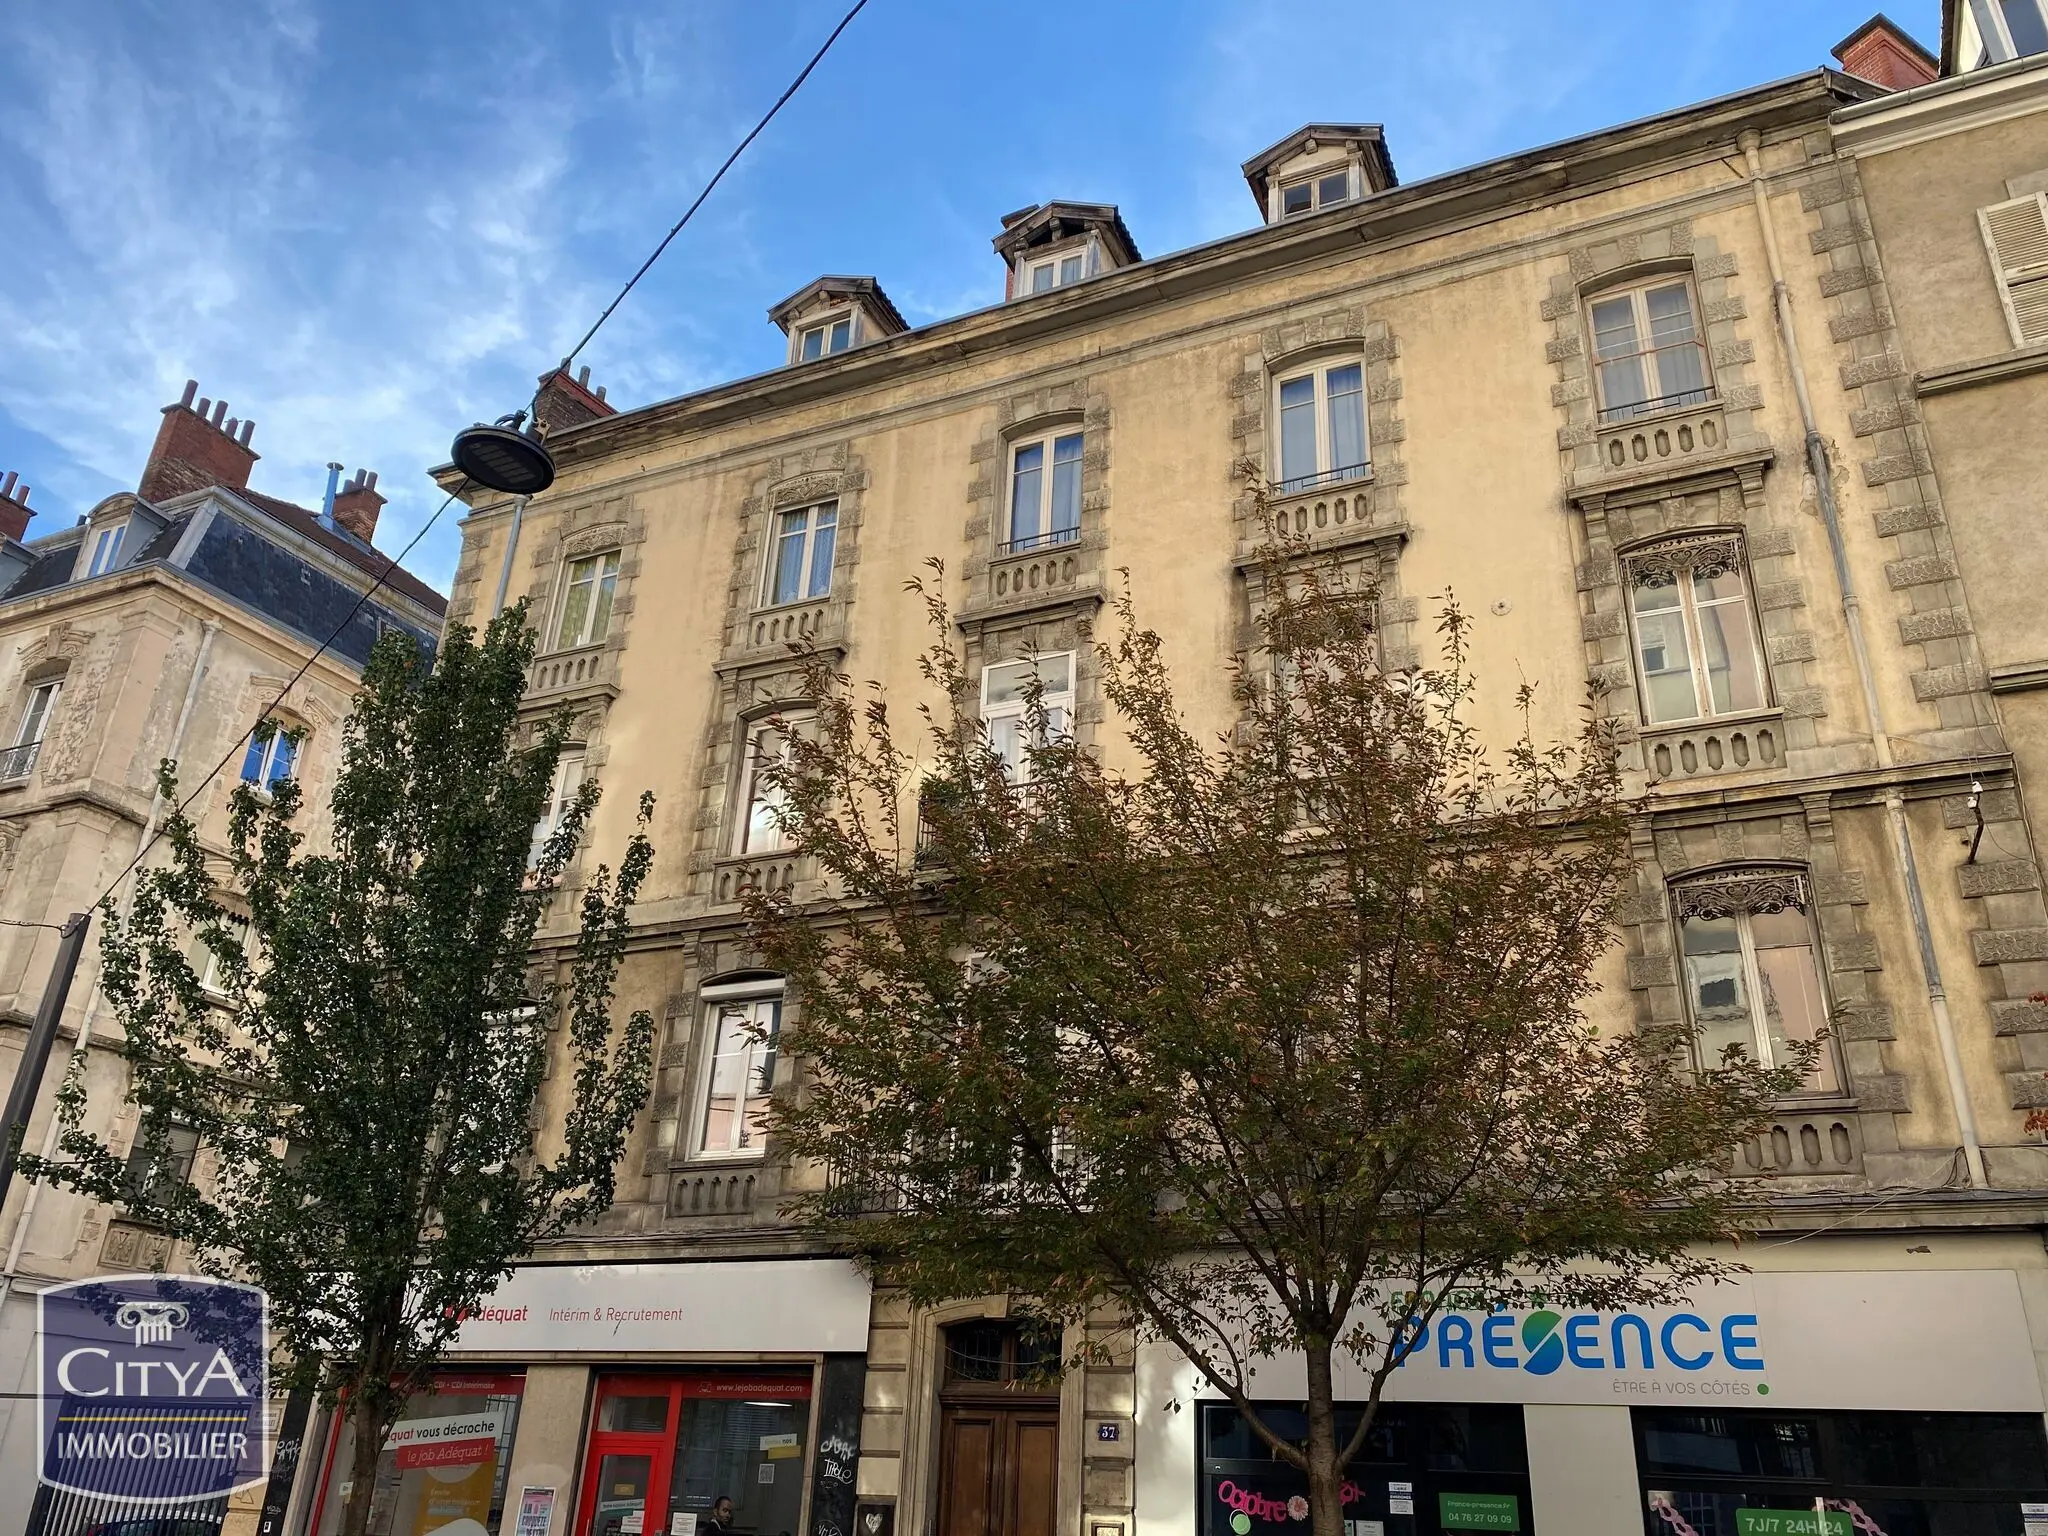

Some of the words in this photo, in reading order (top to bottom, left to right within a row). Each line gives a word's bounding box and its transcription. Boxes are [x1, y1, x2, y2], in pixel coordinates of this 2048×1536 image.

[549, 1307, 590, 1322] Intérim
[593, 1307, 603, 1322] &
[606, 1307, 683, 1322] Recrutement
[1393, 1303, 1765, 1376] PRÉSENCE
[1612, 1378, 1647, 1394] ÊTRE
[1651, 1379, 1662, 1394] À
[1665, 1382, 1696, 1395] VOS
[1700, 1380, 1750, 1396] CÔTÉS
[389, 1427, 414, 1444] quat
[416, 1428, 440, 1438] vous
[443, 1420, 495, 1436] décroche
[1102, 1426, 1116, 1438] 37
[407, 1450, 416, 1463] le
[416, 1449, 435, 1466] job
[436, 1445, 482, 1461] Adéquat
[1218, 1480, 1287, 1522] Octobre
[1448, 1512, 1460, 1521] 04
[1462, 1513, 1472, 1522] 76
[1474, 1514, 1485, 1522] 27
[1487, 1514, 1498, 1523] 09
[1500, 1515, 1512, 1524] 09
[1745, 1518, 1780, 1533] 7J/7
